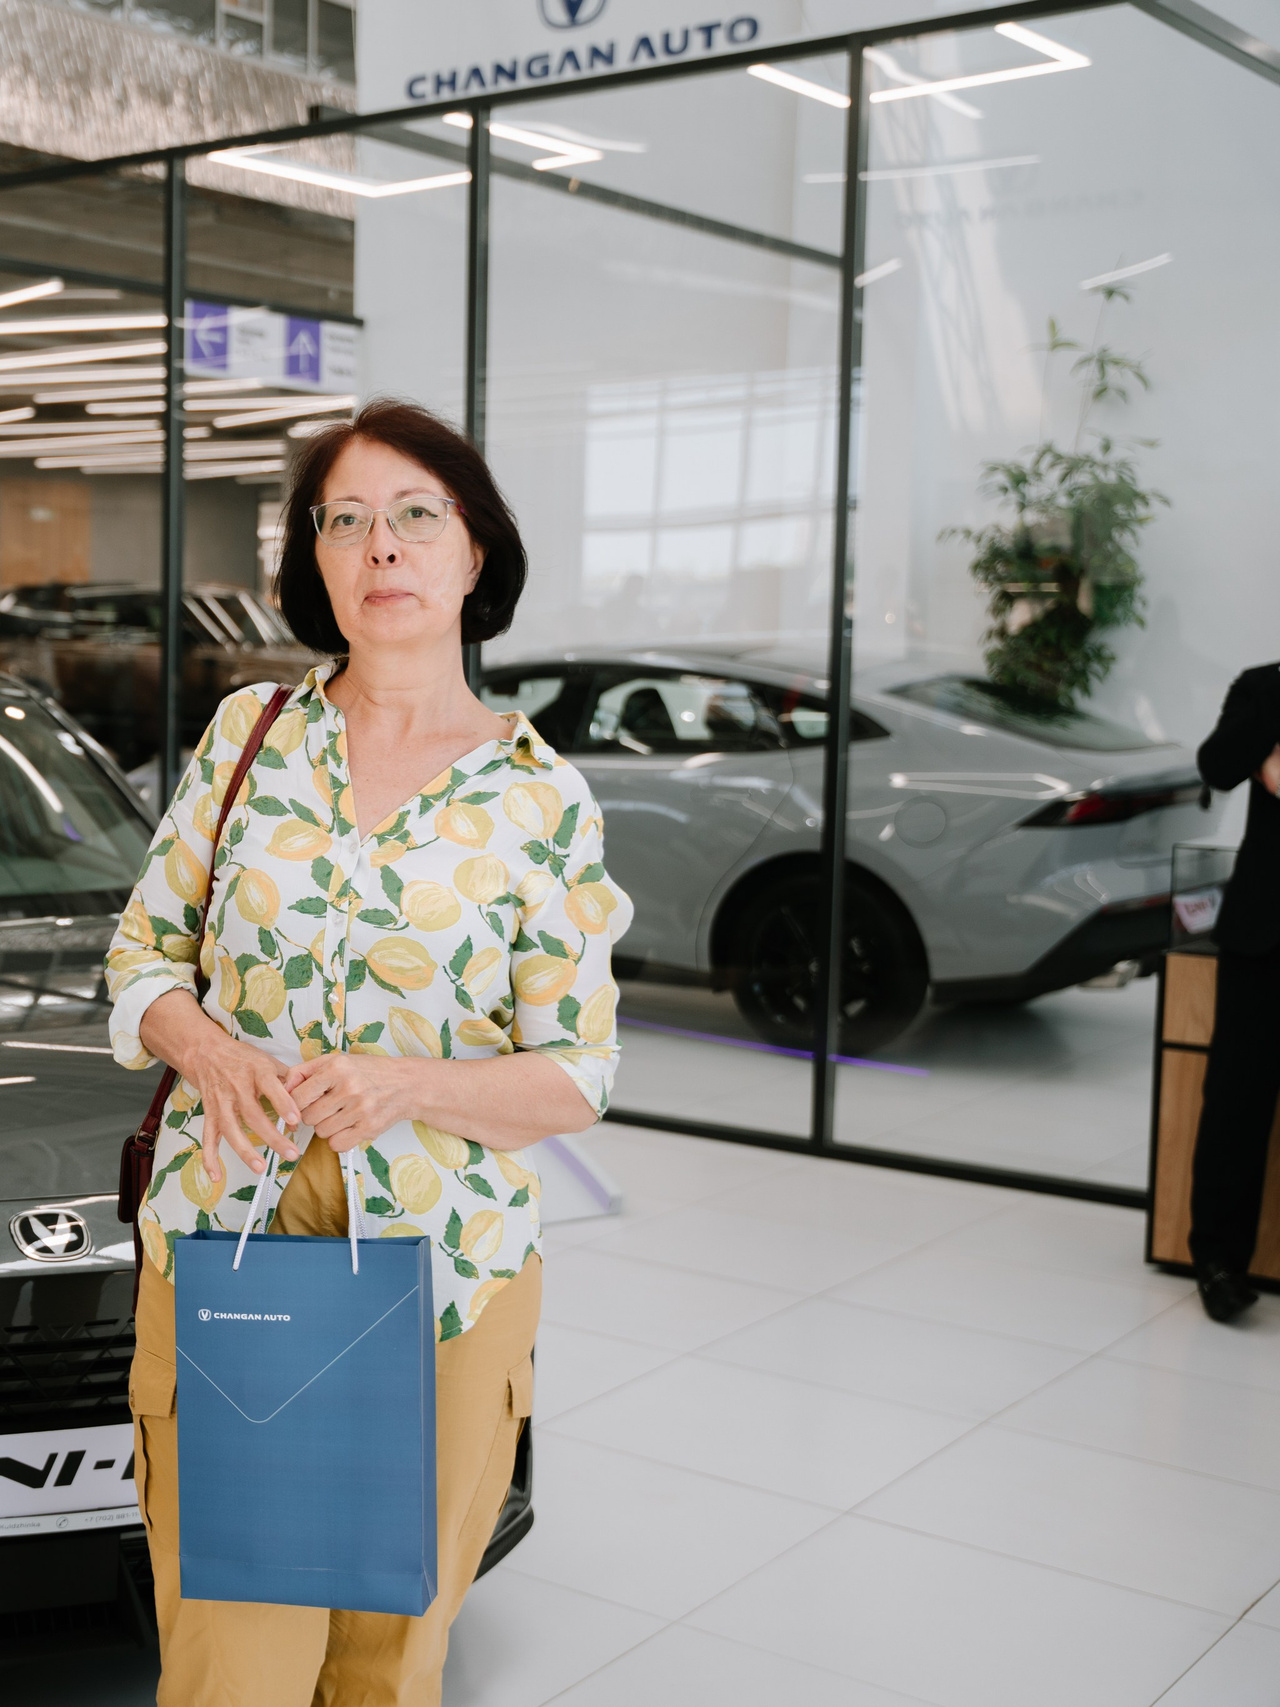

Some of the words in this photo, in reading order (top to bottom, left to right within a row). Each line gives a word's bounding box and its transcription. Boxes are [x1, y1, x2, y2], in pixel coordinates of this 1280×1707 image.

[406, 41, 616, 101] CHANGAN
[629, 15, 761, 63] AUTO
[213, 1312, 262, 1321] CHANGAN
